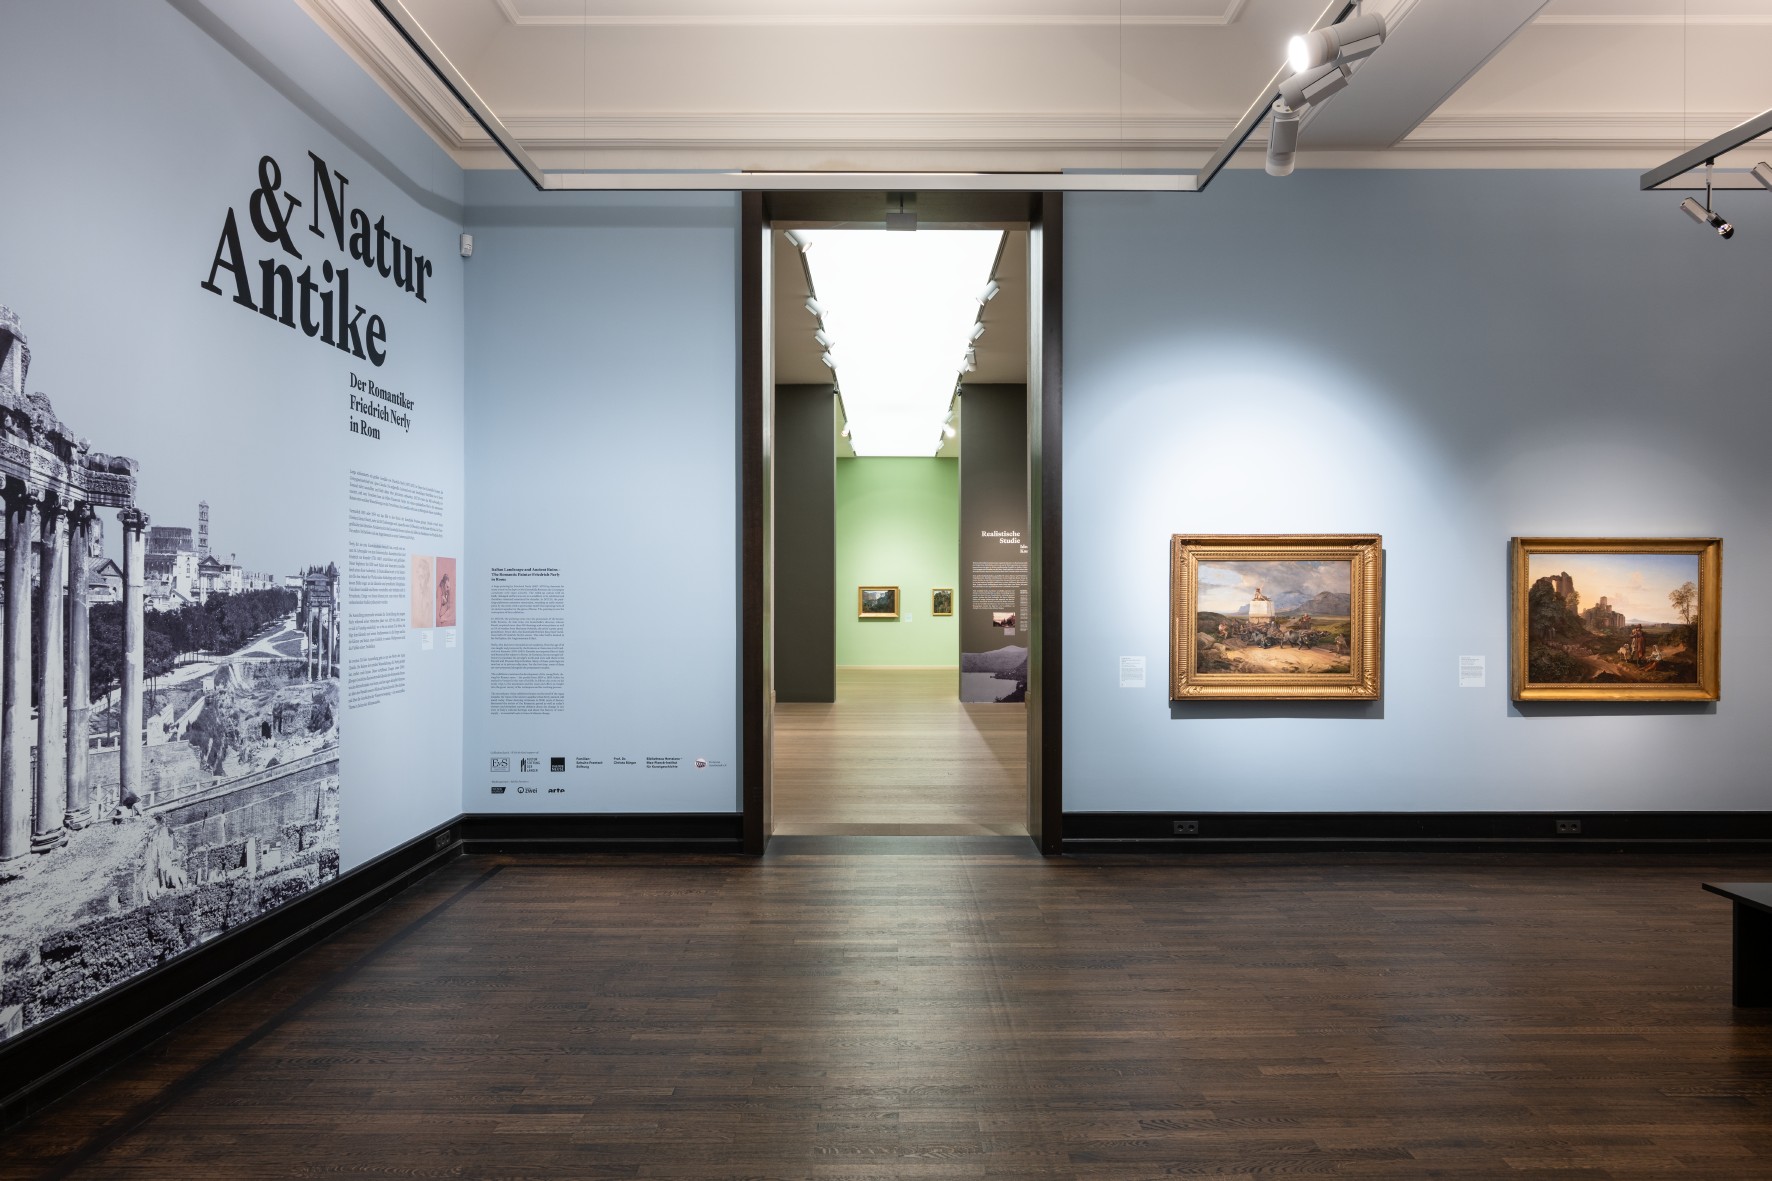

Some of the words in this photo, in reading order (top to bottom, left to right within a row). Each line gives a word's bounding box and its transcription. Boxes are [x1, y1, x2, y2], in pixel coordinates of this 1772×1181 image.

[249, 155, 302, 260] &
[308, 150, 433, 303] Natur
[201, 206, 387, 367] Antike
[350, 372, 367, 392] Der
[368, 379, 415, 411] Romantiker
[350, 393, 389, 422] Friedrich
[390, 409, 411, 433] Nerly
[350, 415, 359, 433] in
[360, 419, 381, 440] Rom
